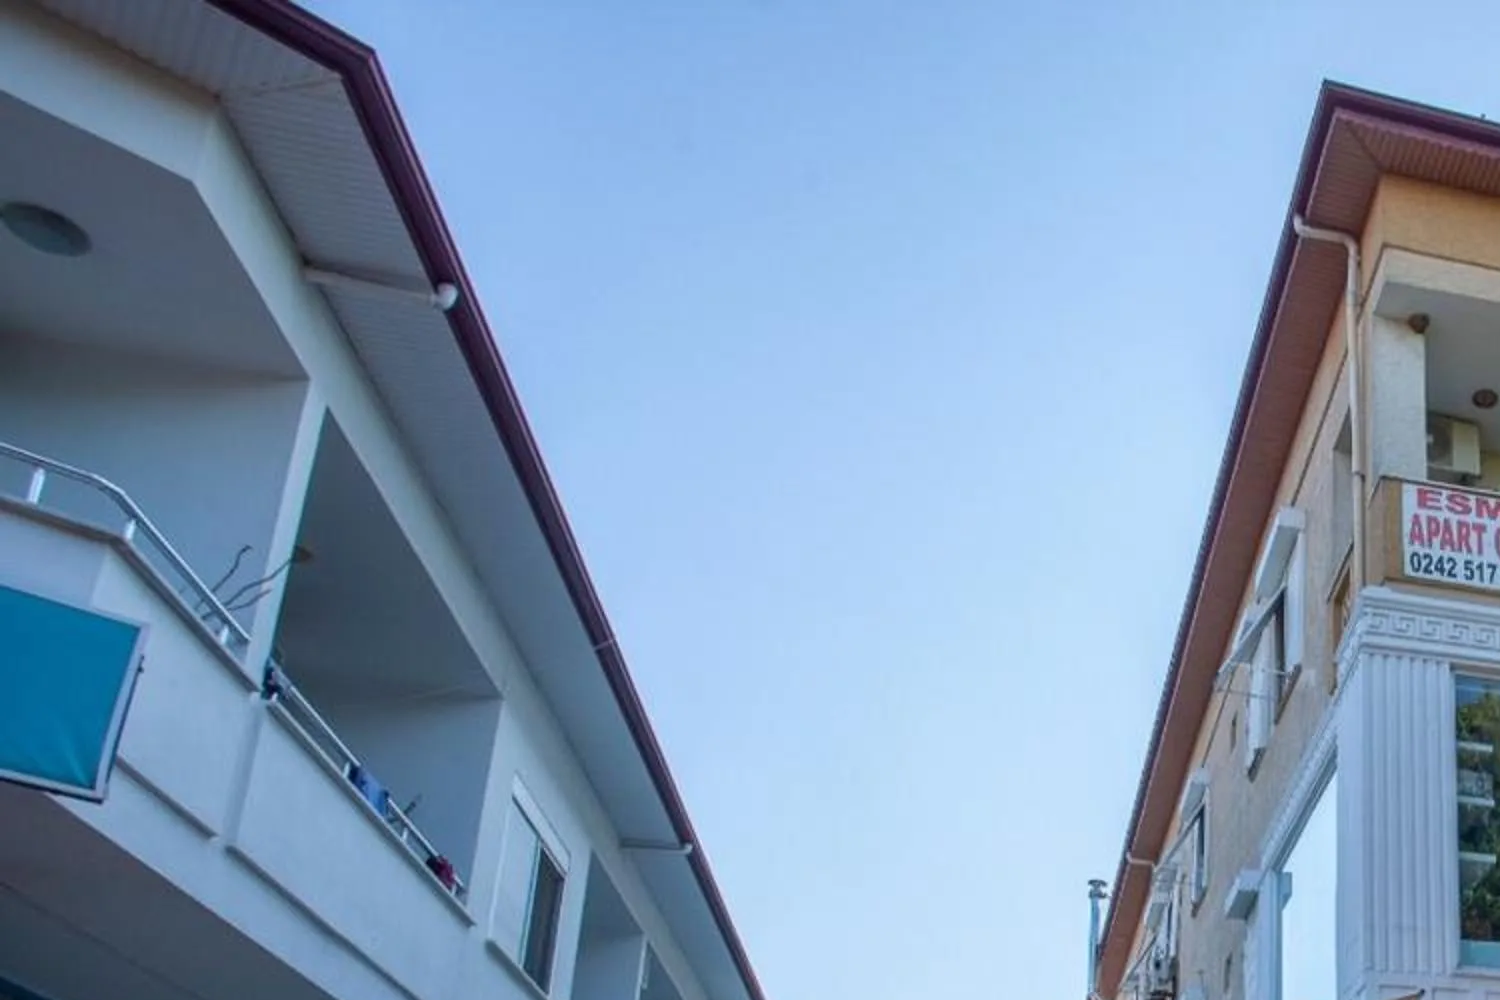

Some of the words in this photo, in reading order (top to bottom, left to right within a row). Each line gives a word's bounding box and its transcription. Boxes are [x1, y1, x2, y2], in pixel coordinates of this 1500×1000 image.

[1408, 513, 1487, 556] APART
[1409, 551, 1458, 579] 0242
[1463, 559, 1498, 585] 517
